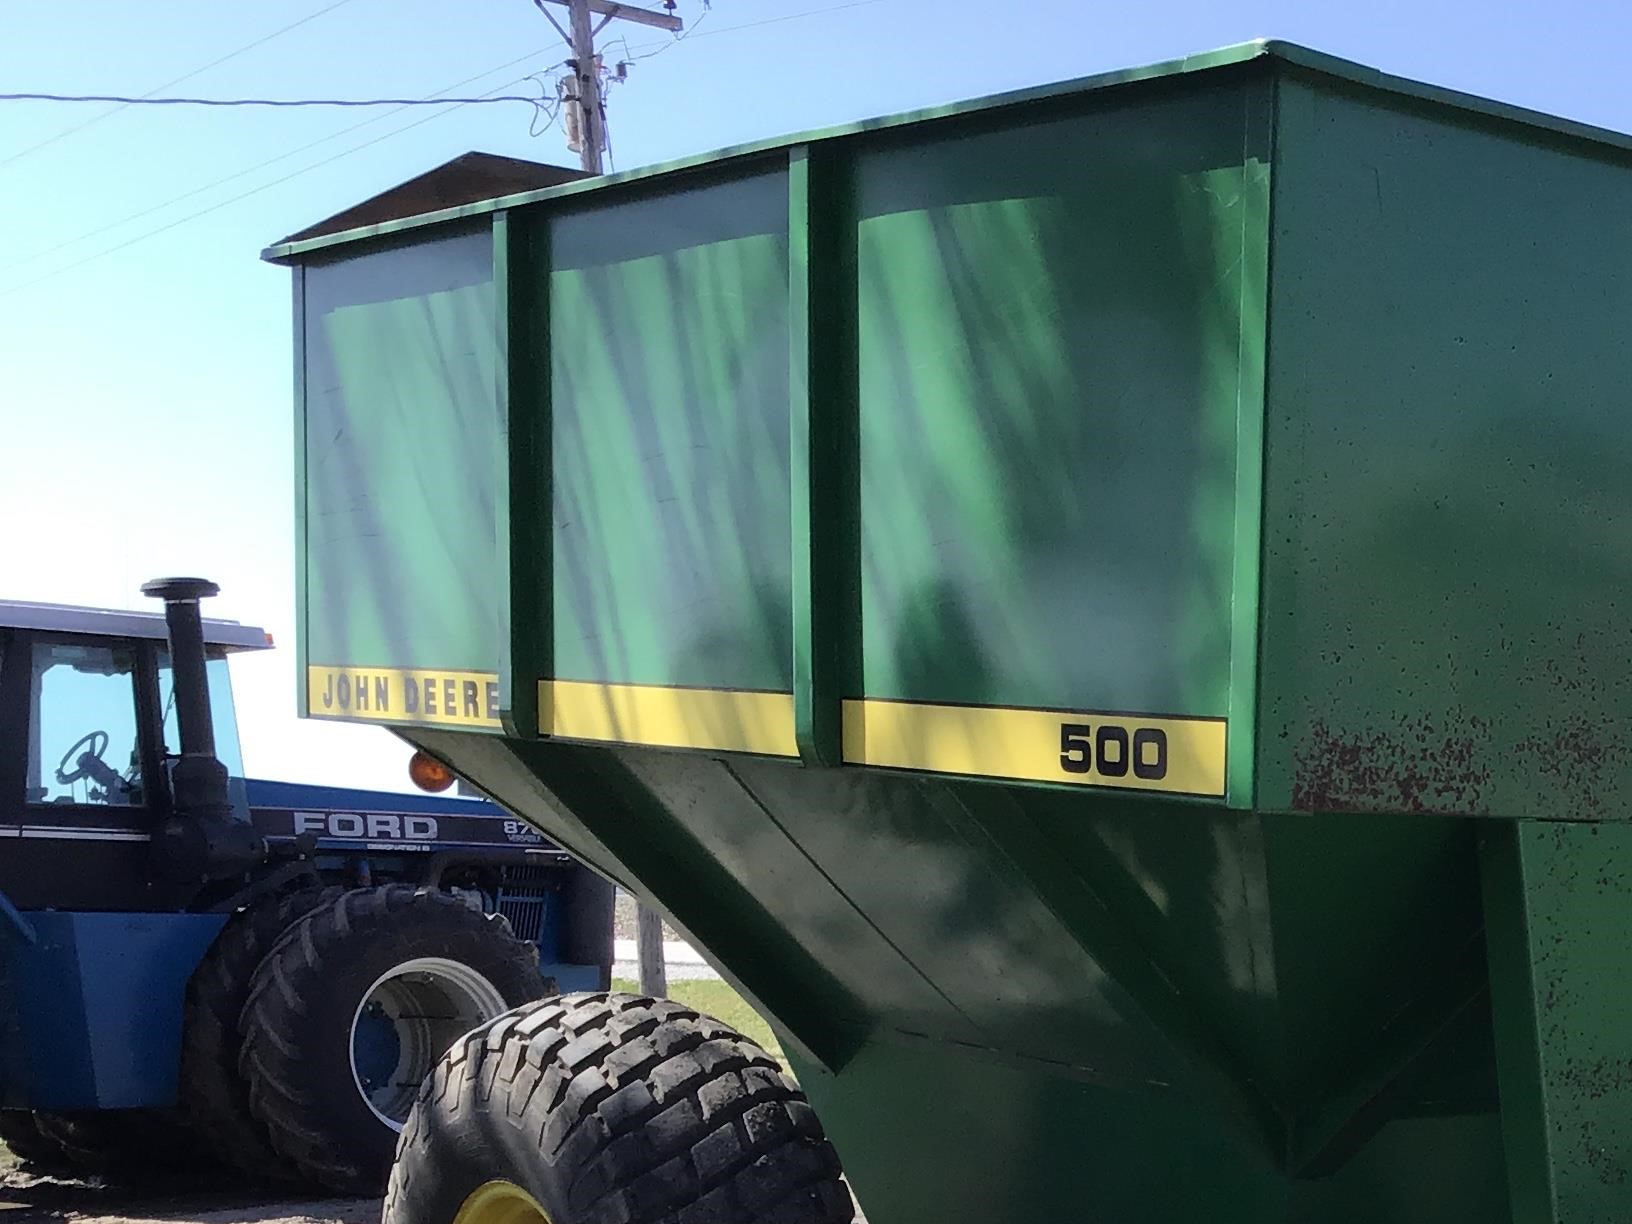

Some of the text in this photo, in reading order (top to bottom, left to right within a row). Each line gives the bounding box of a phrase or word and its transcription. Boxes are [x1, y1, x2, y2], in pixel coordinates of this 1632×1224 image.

[323, 673, 500, 719] JOHN DEERE
[1060, 722, 1168, 780] 500
[293, 812, 438, 840] FORD
